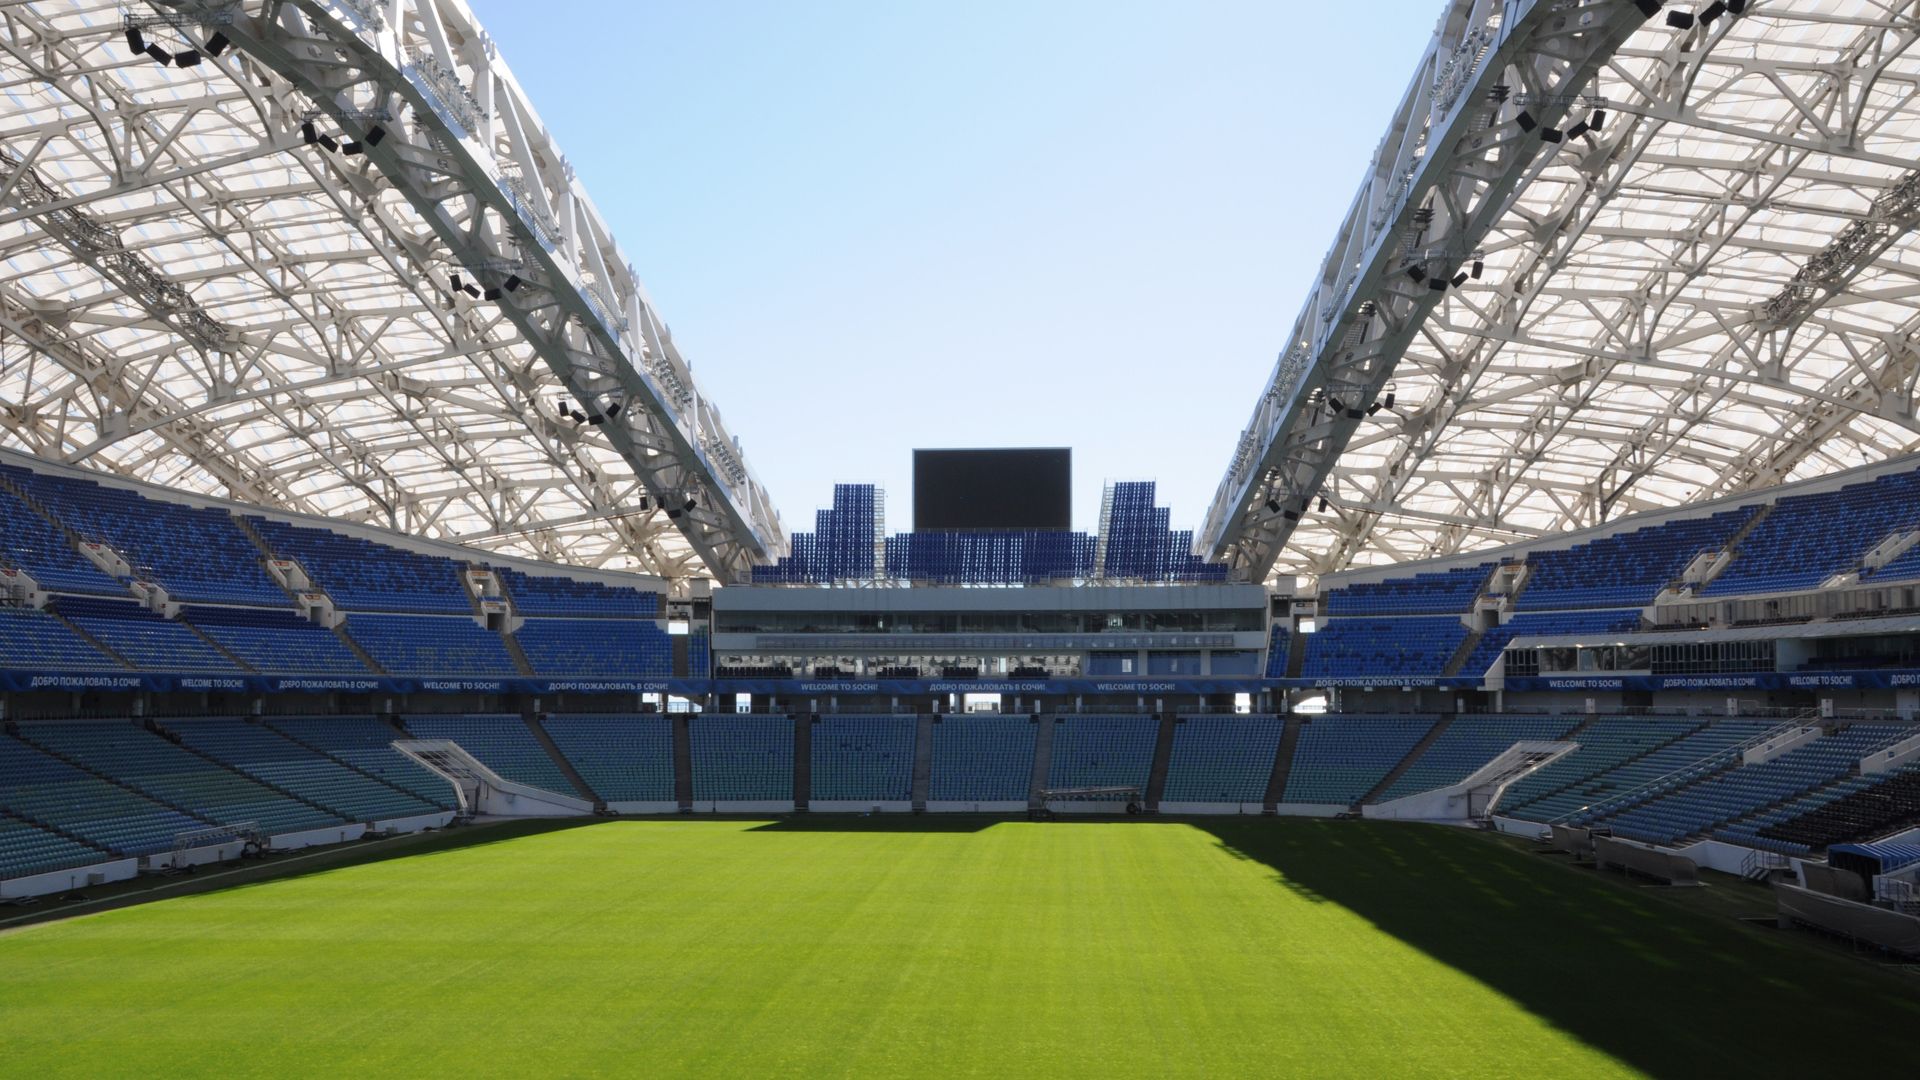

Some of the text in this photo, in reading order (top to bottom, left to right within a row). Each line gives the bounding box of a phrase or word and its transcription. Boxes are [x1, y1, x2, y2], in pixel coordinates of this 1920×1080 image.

[31, 676, 59, 687] ДОБРО
[60, 677, 112, 687] ПОЖАЛОВАТЬ
[181, 679, 213, 688] WELCOME
[213, 680, 222, 688] TO
[1315, 679, 1343, 687] ДОБРО
[1345, 679, 1403, 687] ПОЖАЛОВАТЬ
[1549, 680, 1586, 688] WELCOME
[1587, 680, 1597, 688] TO
[1663, 678, 1687, 688] ДОБРО
[1687, 678, 1733, 687] ПОЖАЛОВАТЬ
[1789, 676, 1820, 685] WELCOME
[1820, 676, 1829, 685] TO
[1891, 674, 1916, 686] ДОБРО
[279, 680, 300, 689] ДОБРО
[301, 681, 350, 689] ПОЖАЛОВАТЬ
[423, 682, 461, 690] WELCOME
[462, 682, 473, 690] TO
[548, 683, 577, 691] ДОБРО
[801, 683, 838, 691] WELCOME
[840, 683, 851, 691] TO
[929, 683, 957, 691] ДОБРО
[958, 683, 1014, 691] ПОЖАЛОВАТЬ
[1097, 683, 1135, 691] WELCOME
[1137, 683, 1148, 691] TO
